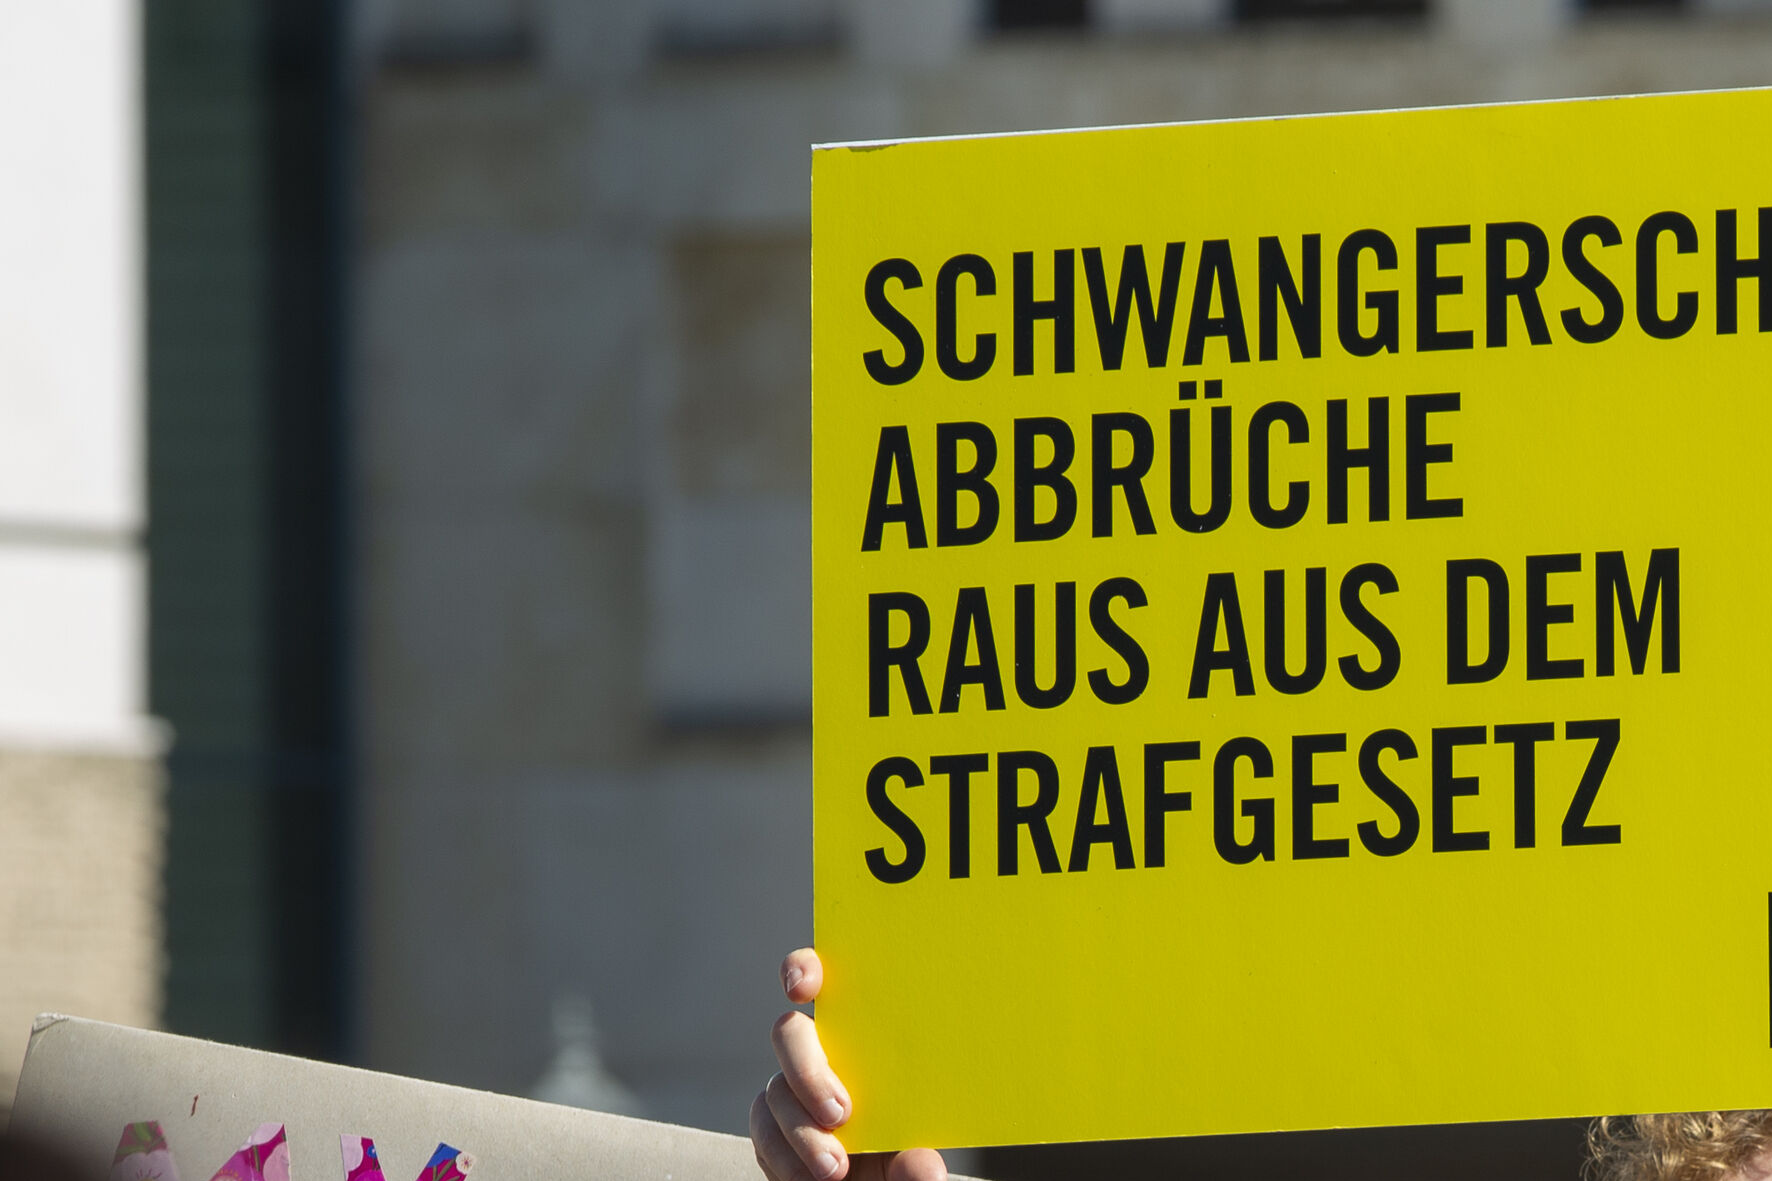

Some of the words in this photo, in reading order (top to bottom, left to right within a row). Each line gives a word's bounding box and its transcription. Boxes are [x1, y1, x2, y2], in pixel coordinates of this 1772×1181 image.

[860, 380, 1464, 553] ABBRÜCHE
[868, 576, 1150, 718] RAUS
[1187, 562, 1401, 700] AUS
[1446, 548, 1681, 685] DEM
[864, 718, 1622, 885] STRAFGESETZ
